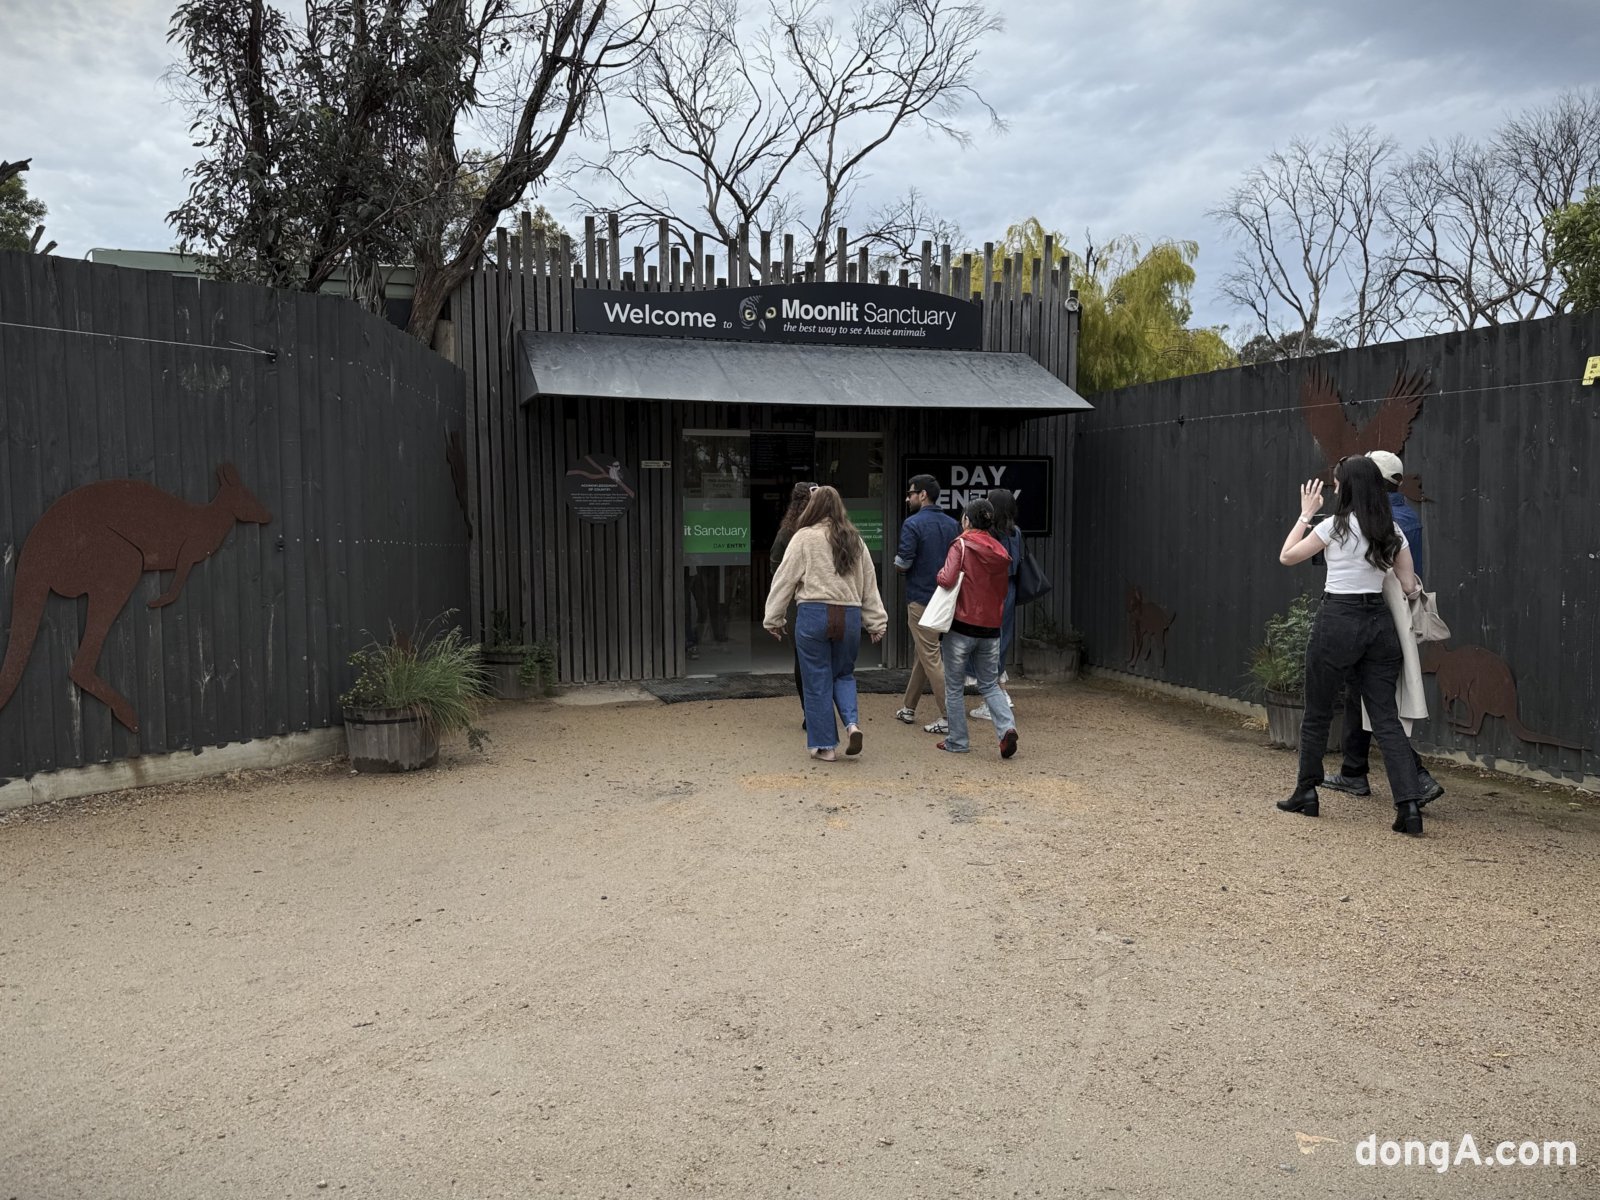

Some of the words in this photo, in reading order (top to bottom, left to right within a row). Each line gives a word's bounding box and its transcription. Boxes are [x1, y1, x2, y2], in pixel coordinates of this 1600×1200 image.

[603, 302, 717, 328] Welcome
[723, 320, 733, 329] to
[782, 298, 859, 322] Moonlit
[863, 302, 957, 330] Sanctuary
[783, 322, 797, 332] the
[799, 323, 816, 333] best
[818, 326, 837, 336] way
[839, 325, 848, 334] to
[850, 327, 863, 335] see
[864, 326, 891, 336] Aussie
[892, 327, 926, 337] animals
[951, 465, 1007, 486] DAY
[694, 524, 748, 539] Sanctuary
